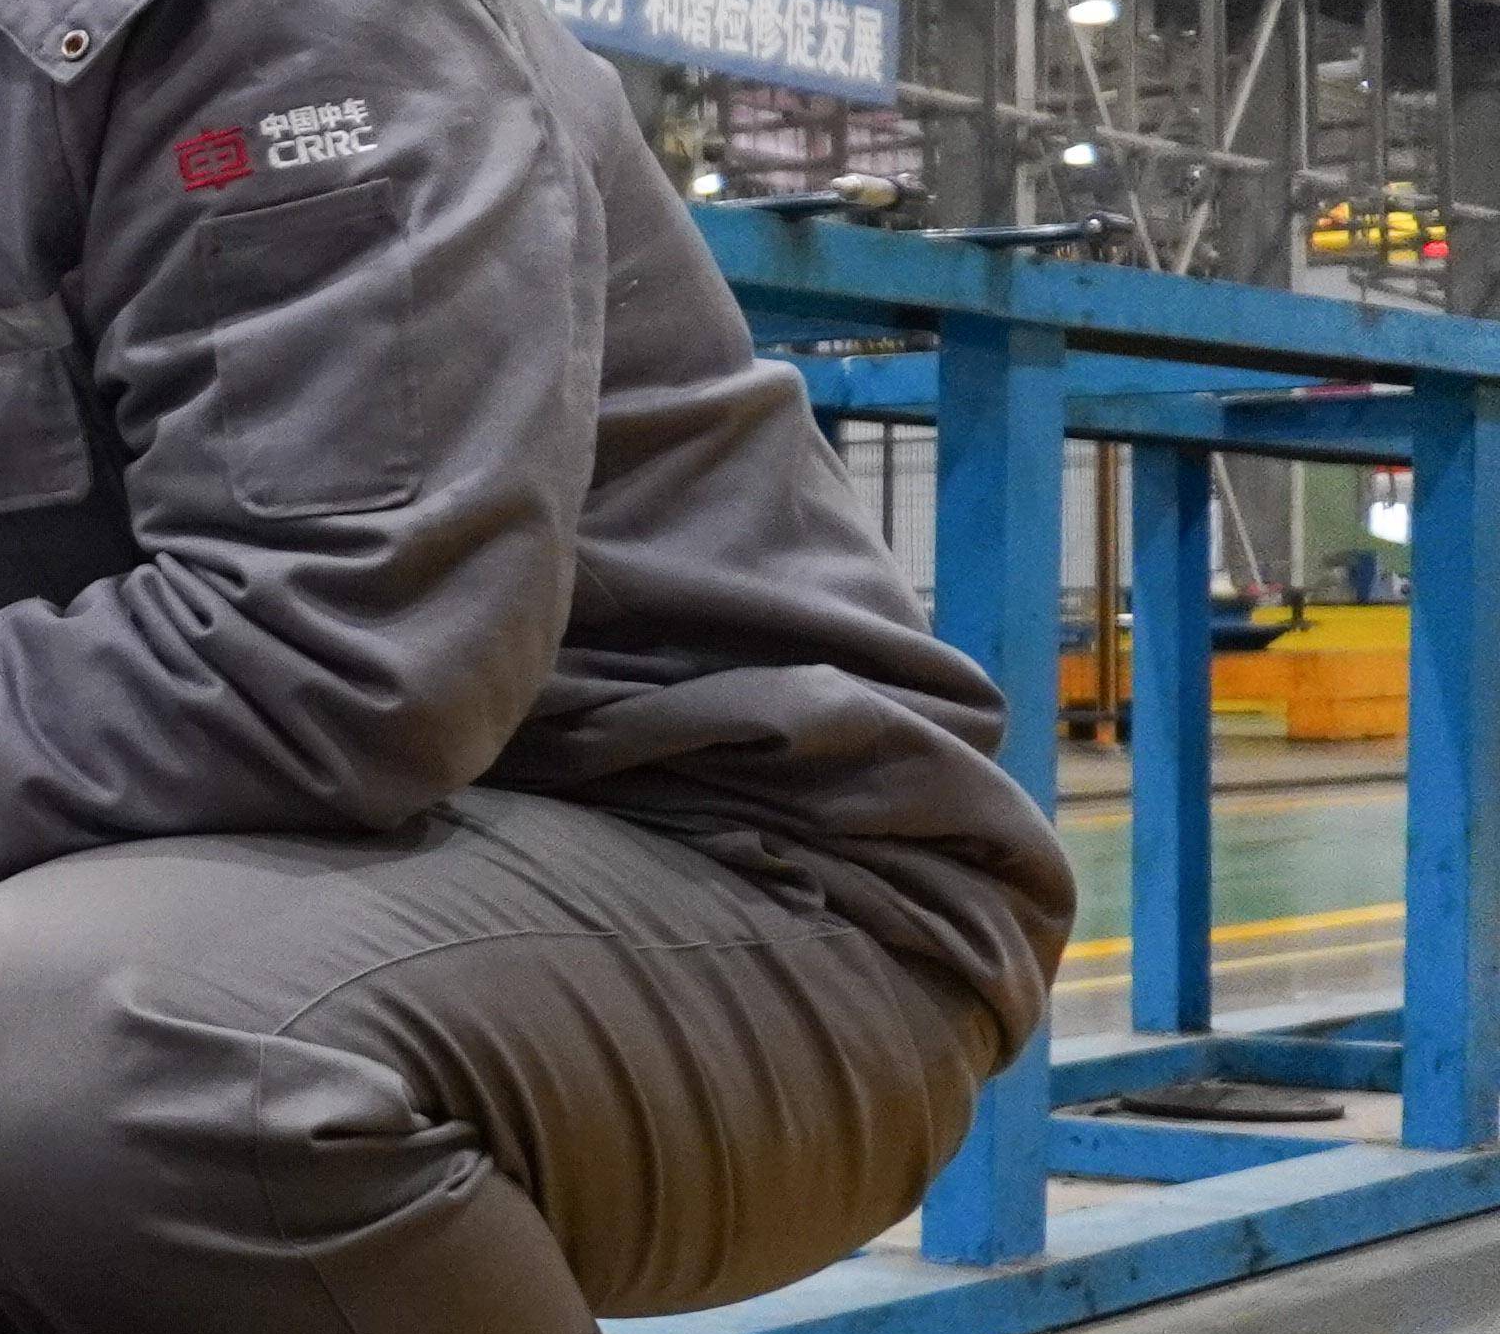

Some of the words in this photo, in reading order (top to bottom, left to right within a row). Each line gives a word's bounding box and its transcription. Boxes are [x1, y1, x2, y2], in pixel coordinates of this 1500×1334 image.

[260, 98, 369, 139] 中国中车
[268, 126, 378, 168] CRRC
